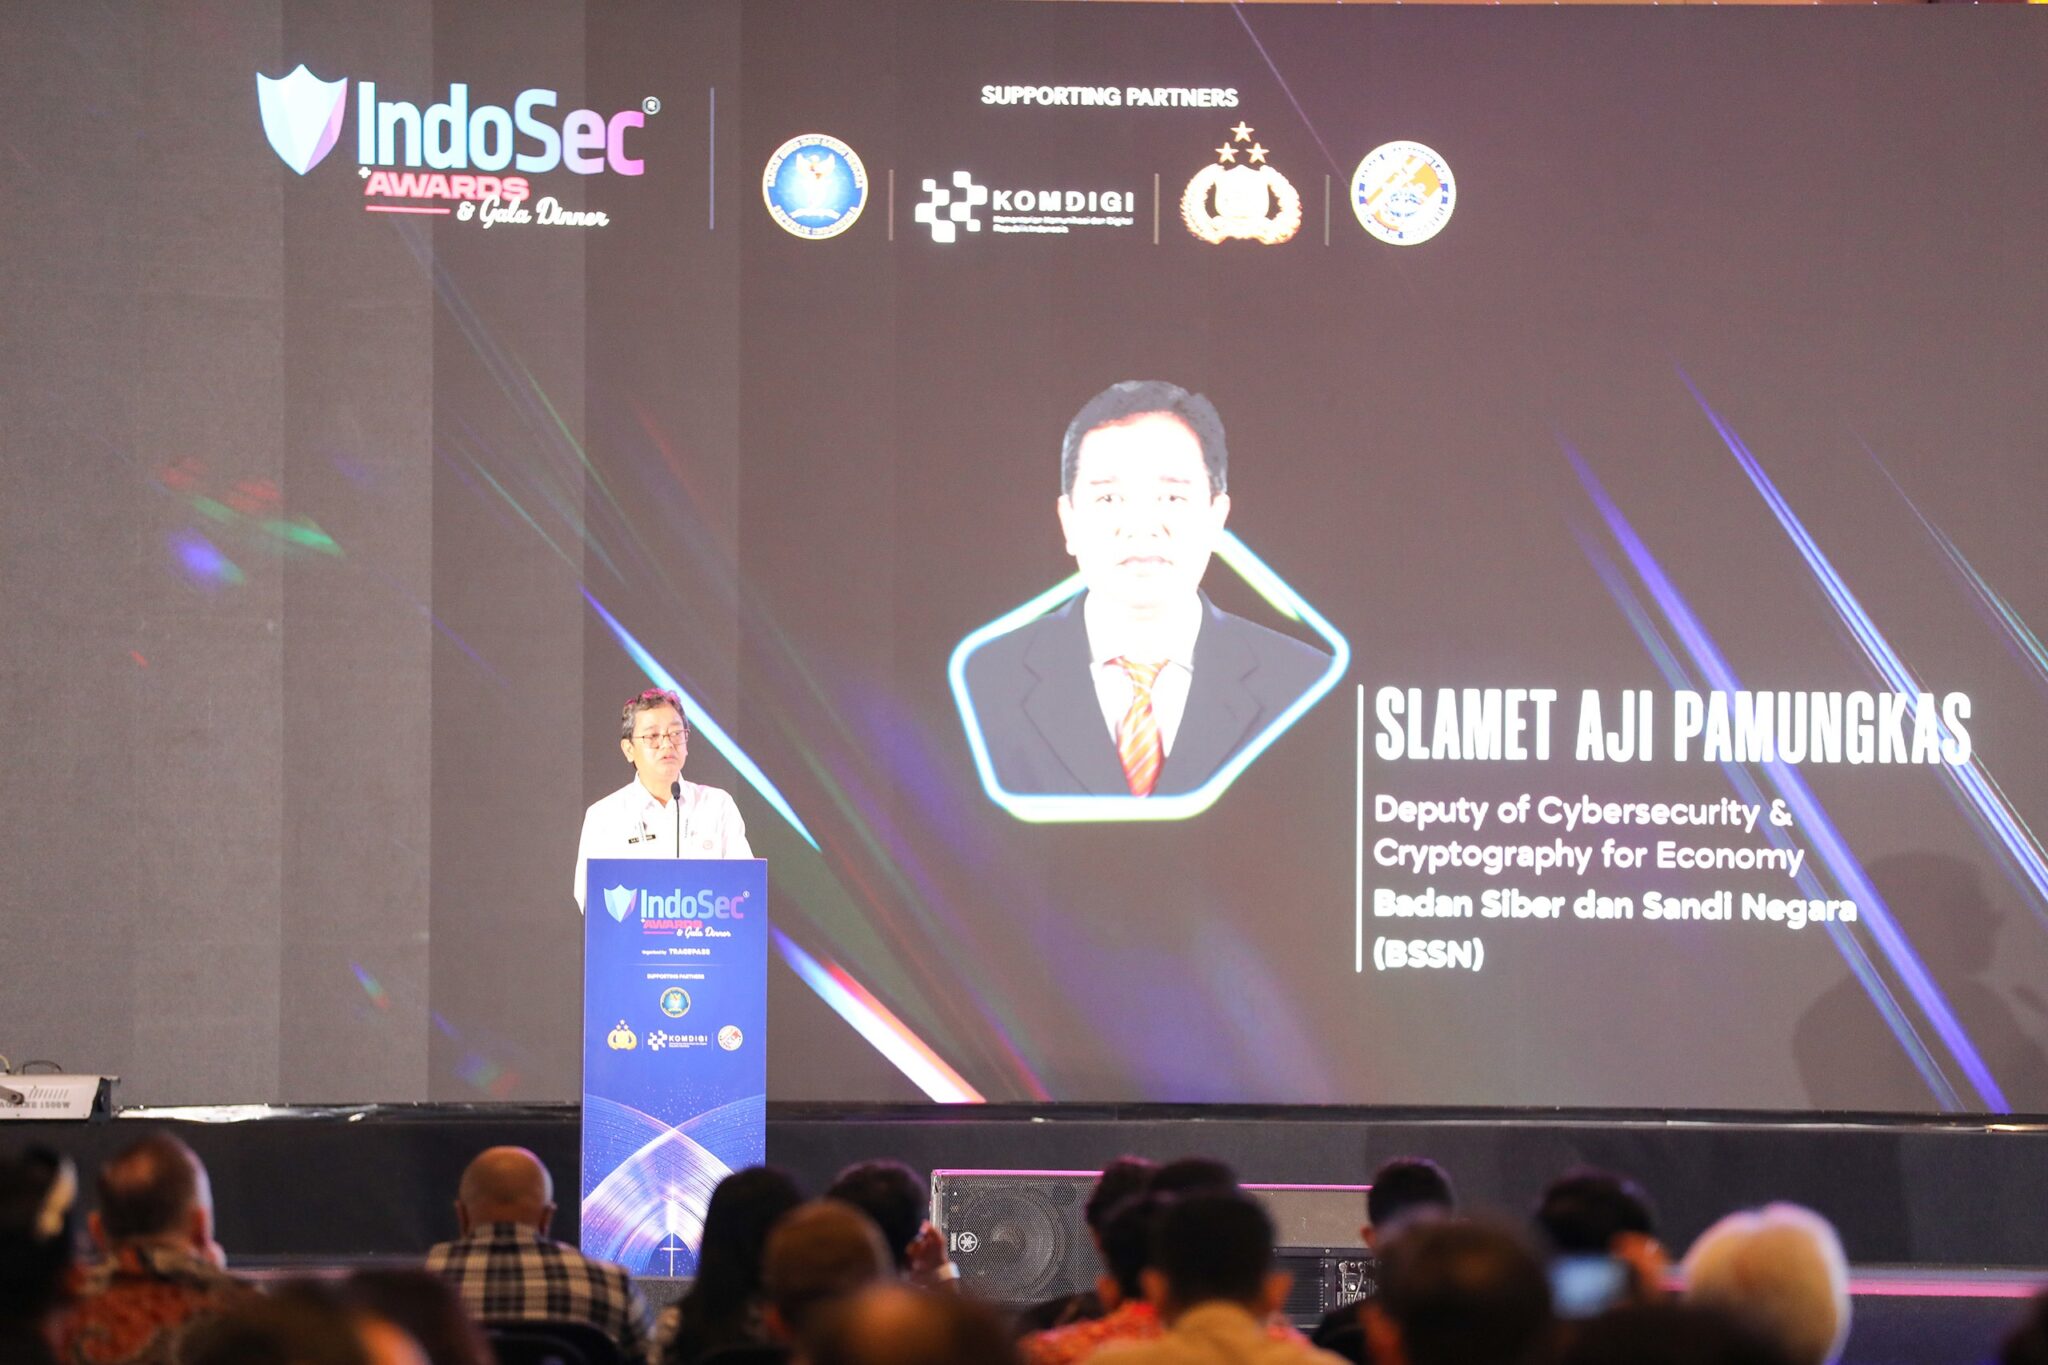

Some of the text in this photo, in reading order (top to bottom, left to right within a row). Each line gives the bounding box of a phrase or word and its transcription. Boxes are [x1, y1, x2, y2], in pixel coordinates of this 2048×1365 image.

[981, 85, 1239, 107] SUPPORTING PARTNERS
[364, 171, 531, 201] AWARDS
[992, 190, 1134, 213] KOMDIGI
[456, 195, 610, 229] & Gala Dinner
[1375, 686, 1973, 765] SLAMET AJI PAMUNGKAS
[1374, 795, 1794, 833] Deputy of Cybersecurity &
[1373, 838, 1805, 877] Cryptography for Economy
[643, 920, 703, 929] AWARDS
[1373, 887, 1858, 930] Badan Siber dan Sandi Negara
[684, 926, 703, 939] Gala
[704, 926, 732, 938] Dinner
[1373, 936, 1485, 972] (BSSN)
